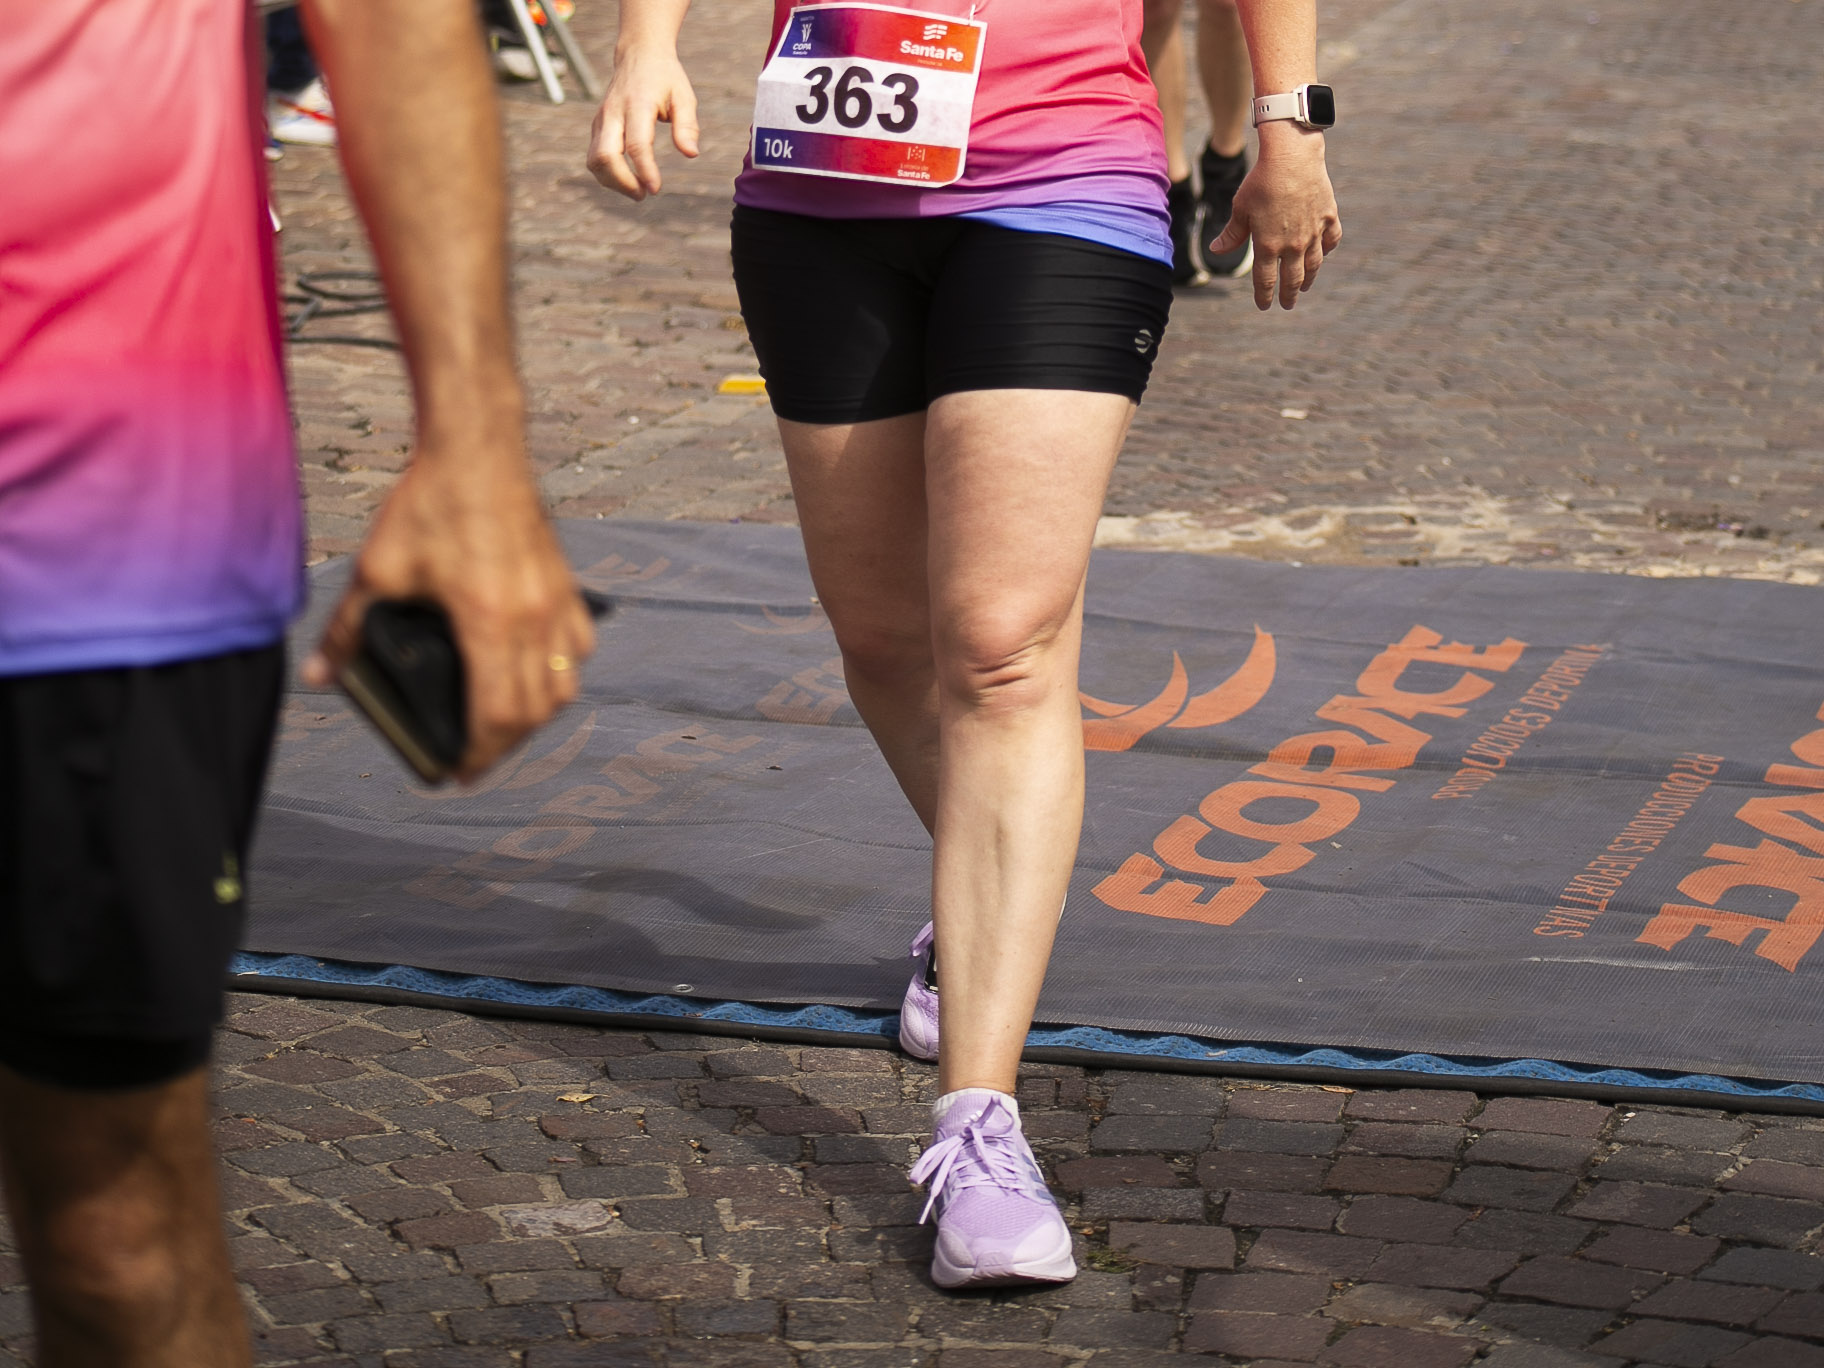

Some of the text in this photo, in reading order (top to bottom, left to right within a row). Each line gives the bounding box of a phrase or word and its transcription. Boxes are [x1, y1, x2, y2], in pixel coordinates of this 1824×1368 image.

[900, 40, 946, 60] Santa
[945, 47, 965, 63] Fe
[795, 65, 920, 134] 363
[764, 138, 795, 160] 10k
[1606, 751, 1725, 853] PRODUCCIONES
